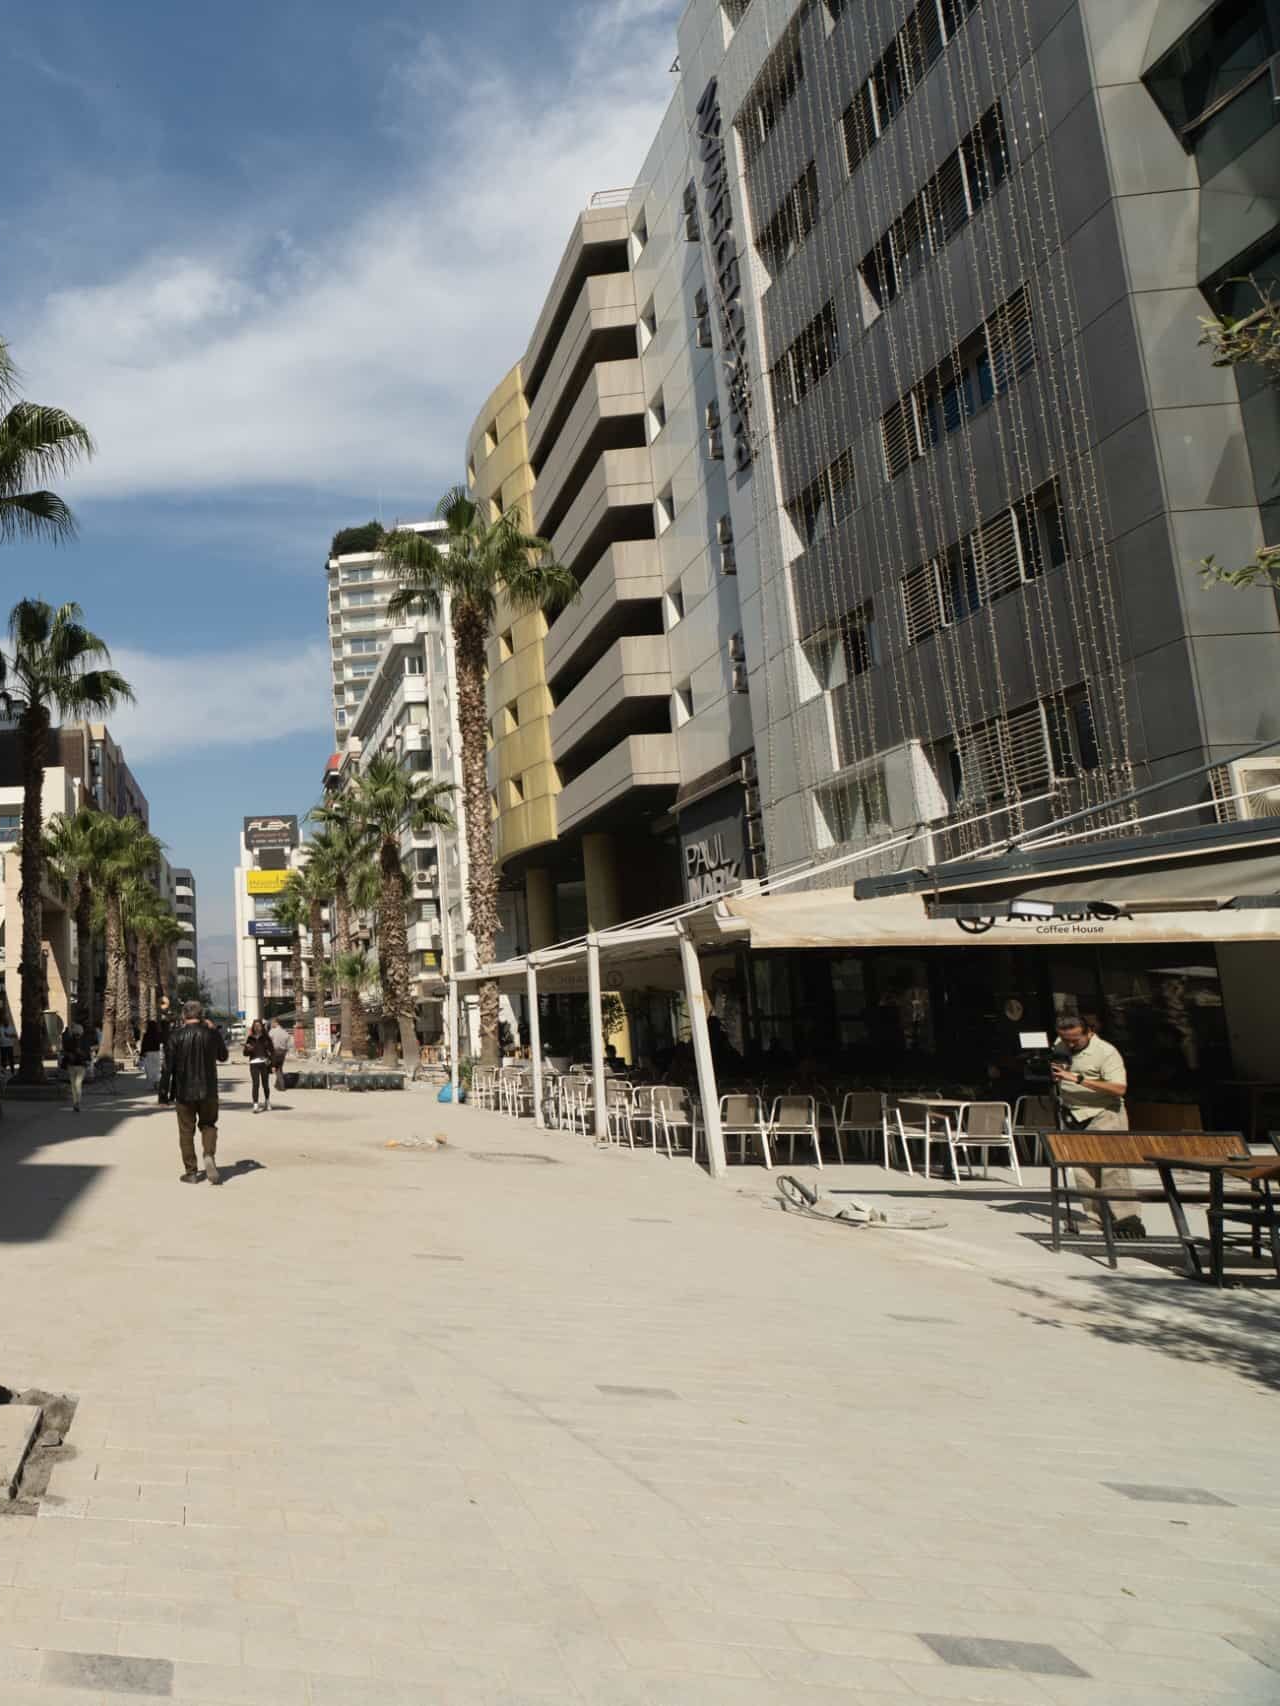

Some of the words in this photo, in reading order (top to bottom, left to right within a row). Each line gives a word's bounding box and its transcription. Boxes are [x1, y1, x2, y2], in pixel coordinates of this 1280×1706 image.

[685, 832, 731, 877] PAUL
[1036, 925, 1069, 935] Coffee
[1072, 924, 1104, 933] House
